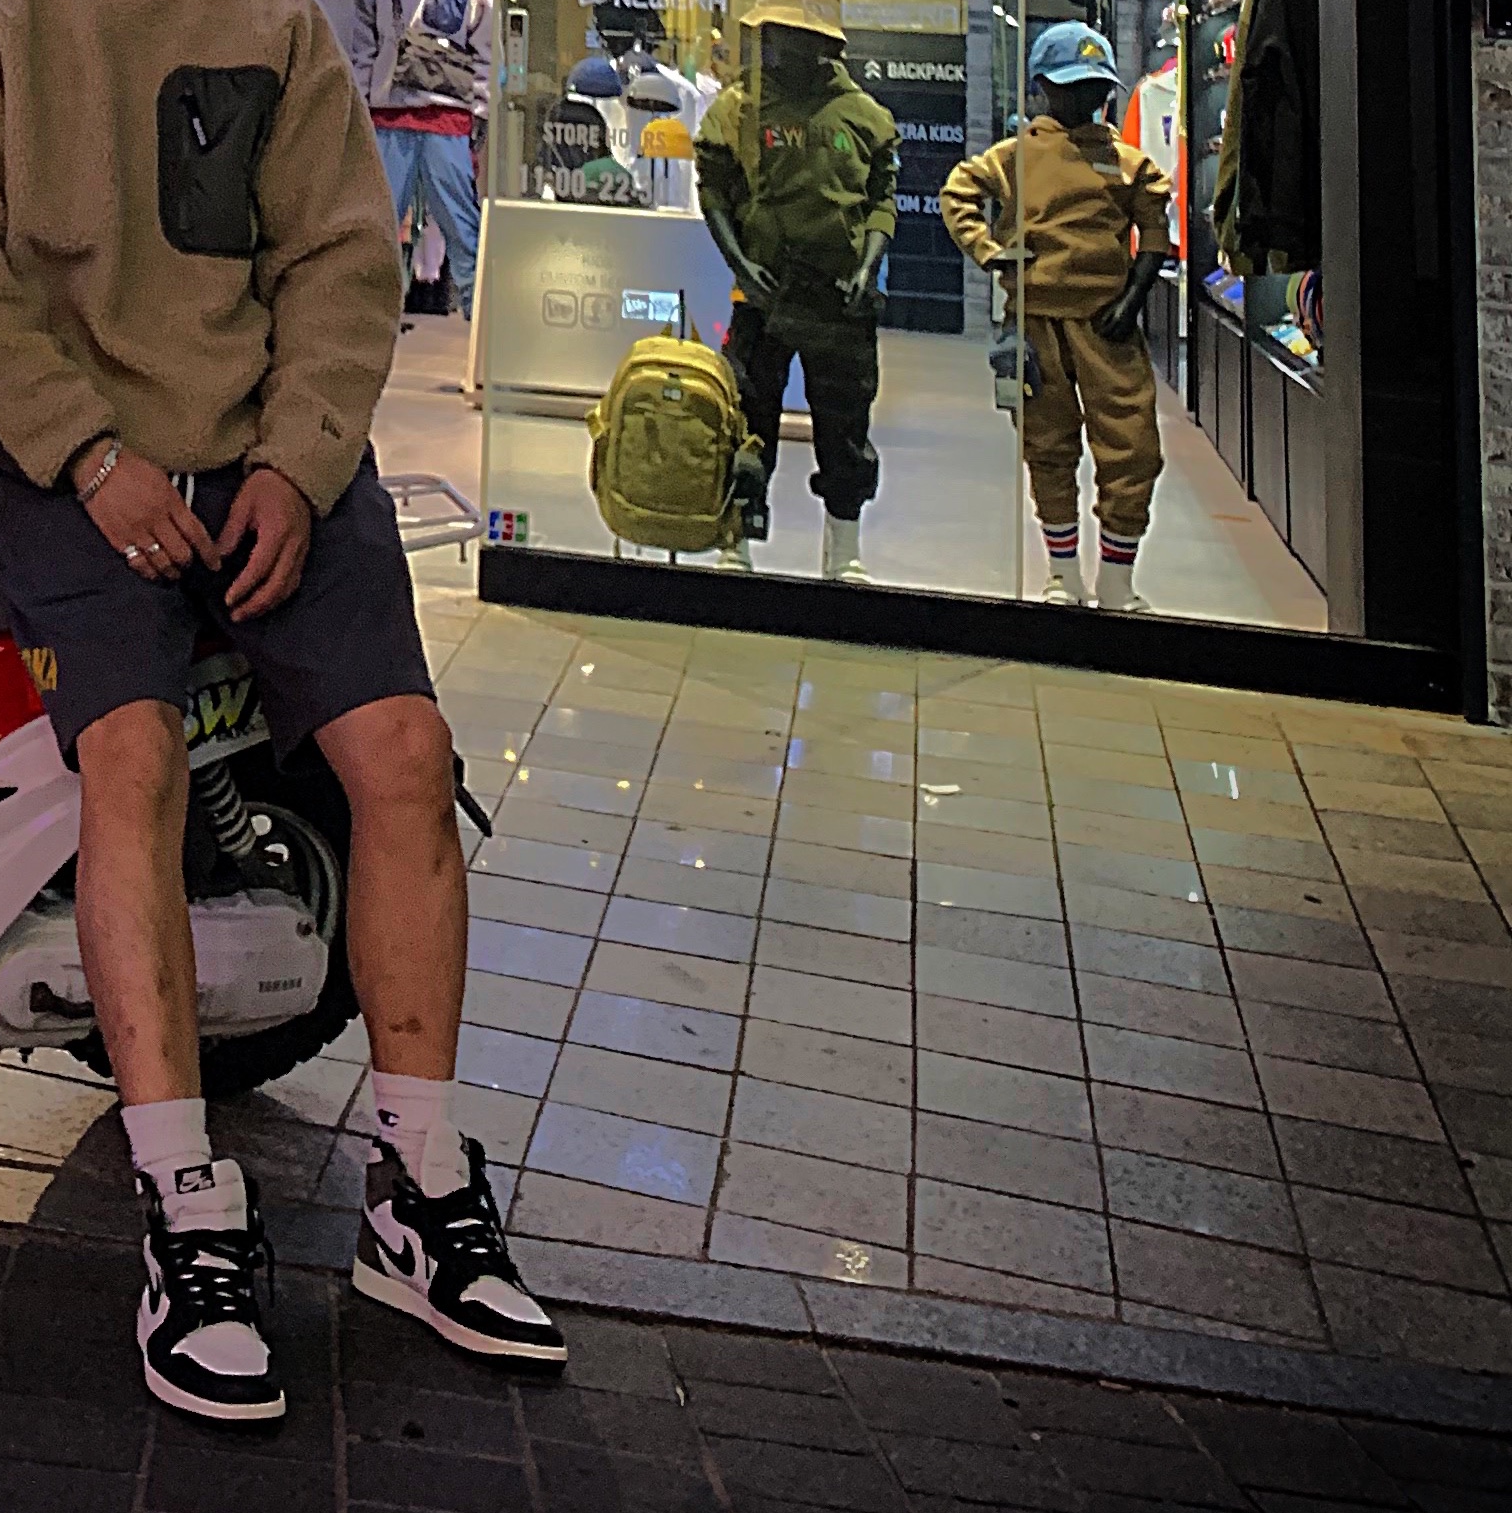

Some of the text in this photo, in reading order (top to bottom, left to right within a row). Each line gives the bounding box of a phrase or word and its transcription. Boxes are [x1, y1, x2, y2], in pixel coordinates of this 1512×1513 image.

[888, 61, 965, 82] BACKPACK
[543, 121, 600, 149] STORE
[929, 124, 965, 144] KIDS
